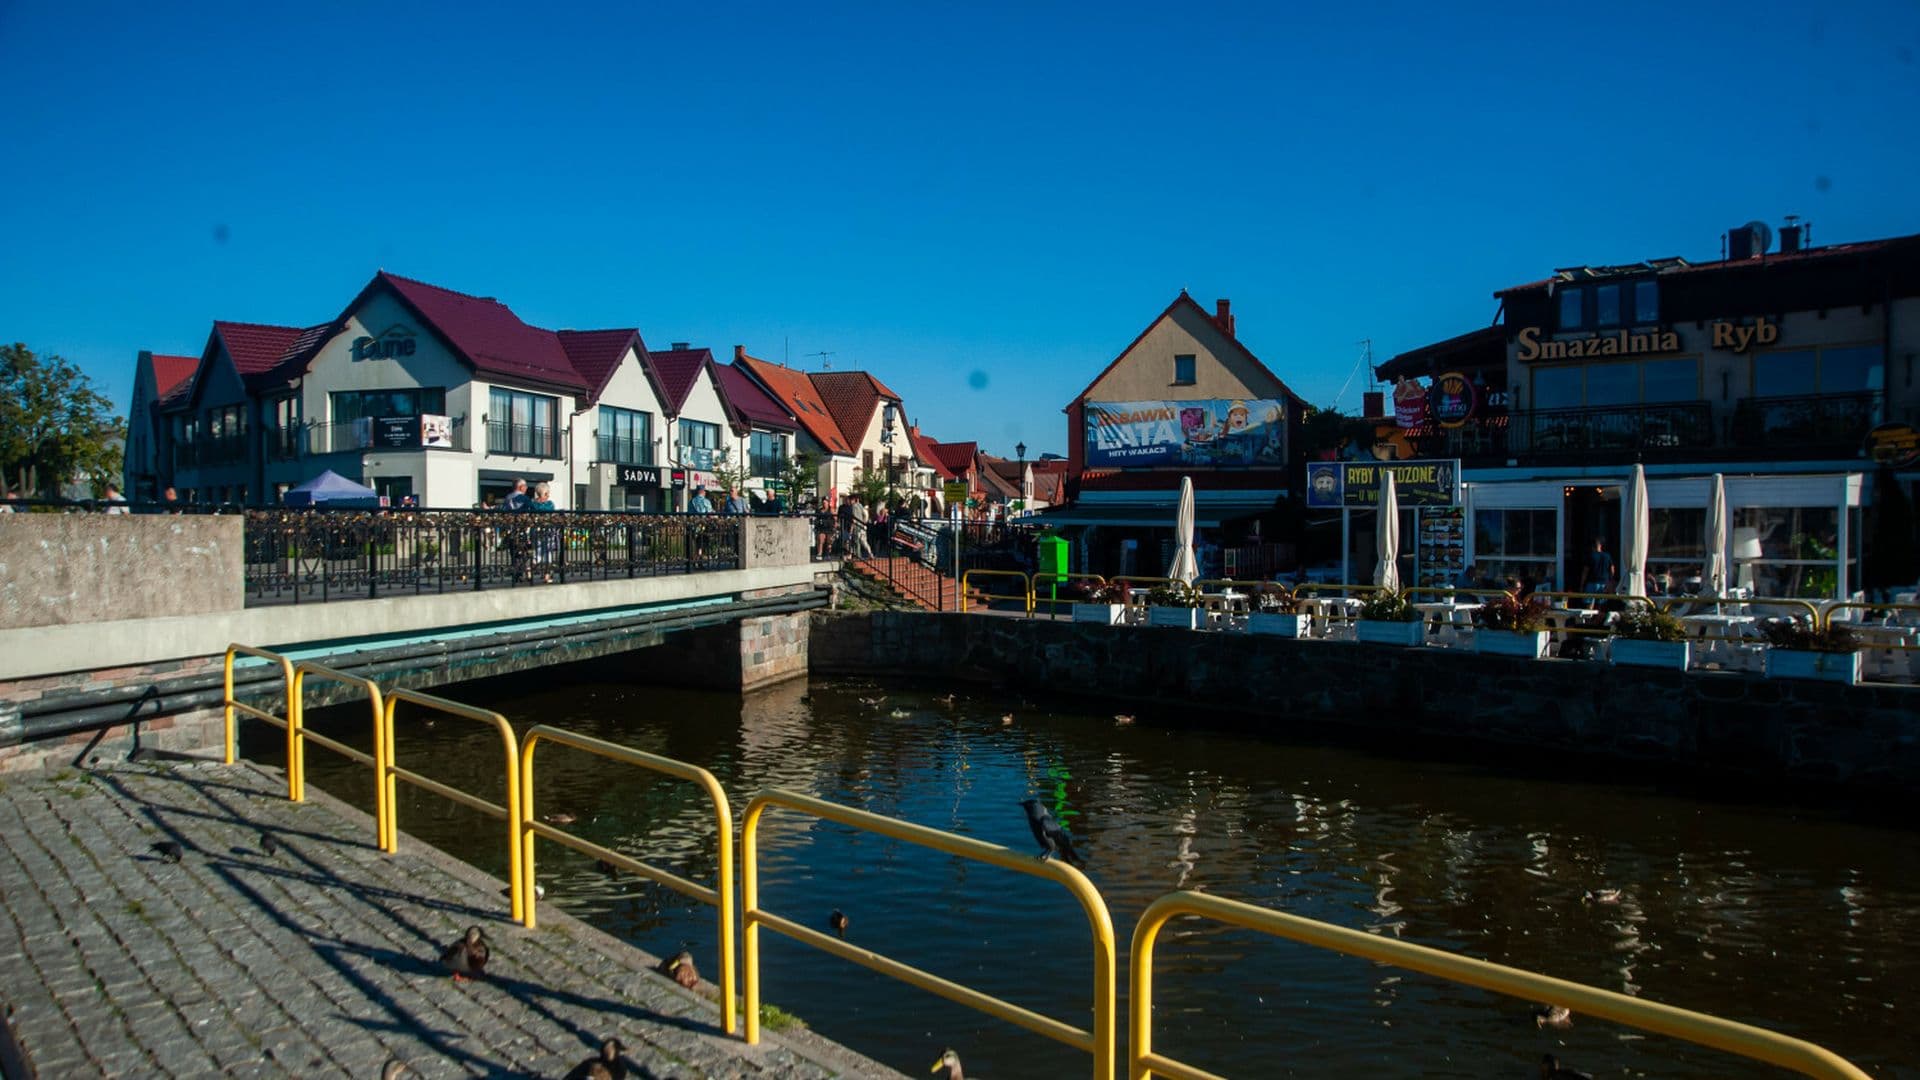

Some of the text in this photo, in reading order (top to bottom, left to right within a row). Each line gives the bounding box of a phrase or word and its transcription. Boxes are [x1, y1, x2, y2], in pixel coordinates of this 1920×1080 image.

[1517, 316, 1778, 361] Smażalnia Ryb
[1097, 419, 1178, 451] LATA
[1108, 446, 1167, 458] HITY WAKACJI
[624, 469, 656, 483] SADVA
[1347, 467, 1374, 485] RYBY
